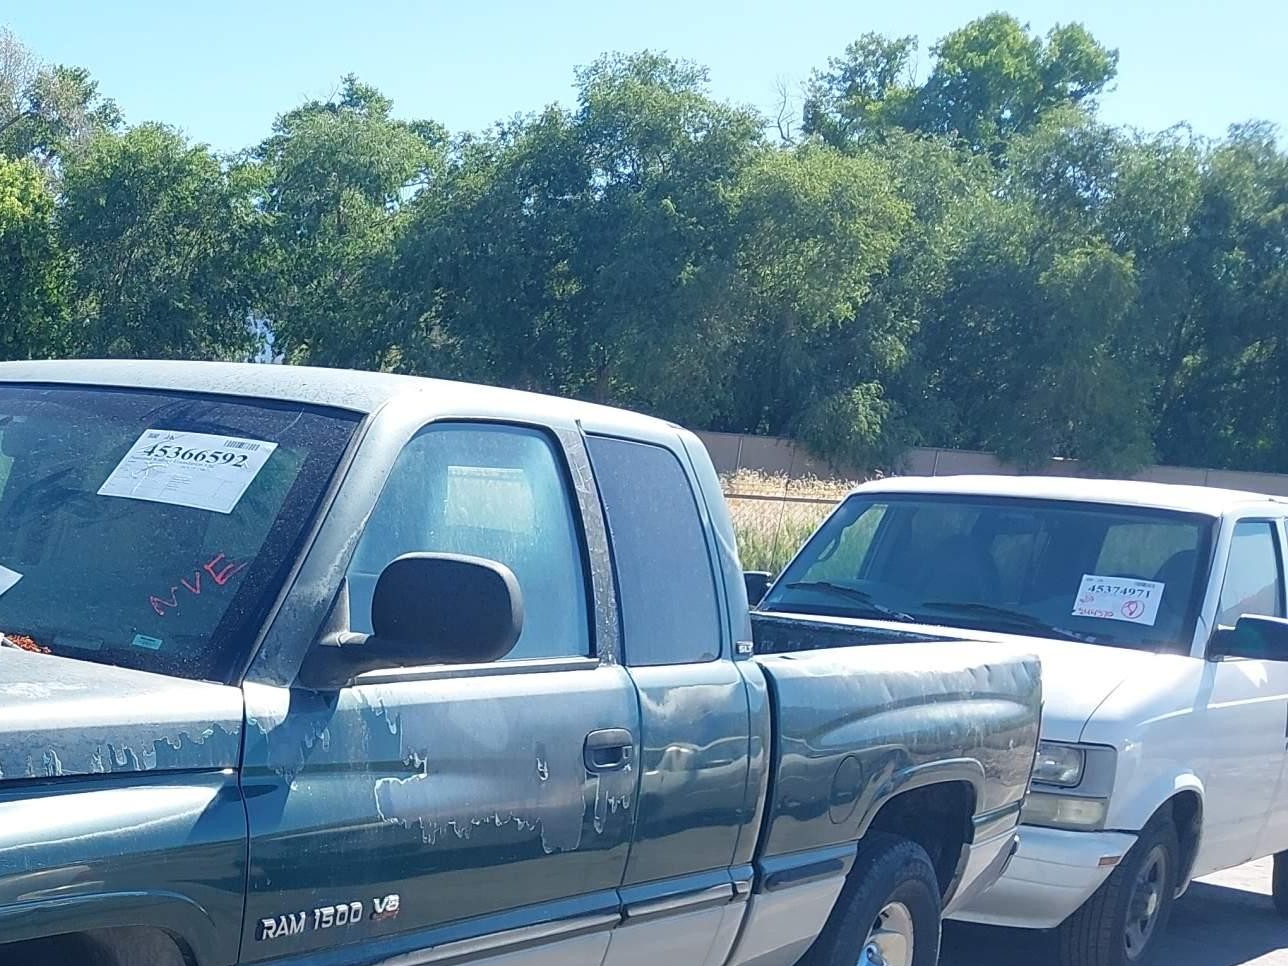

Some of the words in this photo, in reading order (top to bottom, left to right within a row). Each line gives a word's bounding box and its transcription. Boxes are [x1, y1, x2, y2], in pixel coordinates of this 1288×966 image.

[143, 443, 249, 468] 45366592
[1088, 585, 1151, 599] 45374971
[261, 911, 306, 941] RAM
[313, 901, 363, 930] 1500
[373, 893, 400, 914] V8
